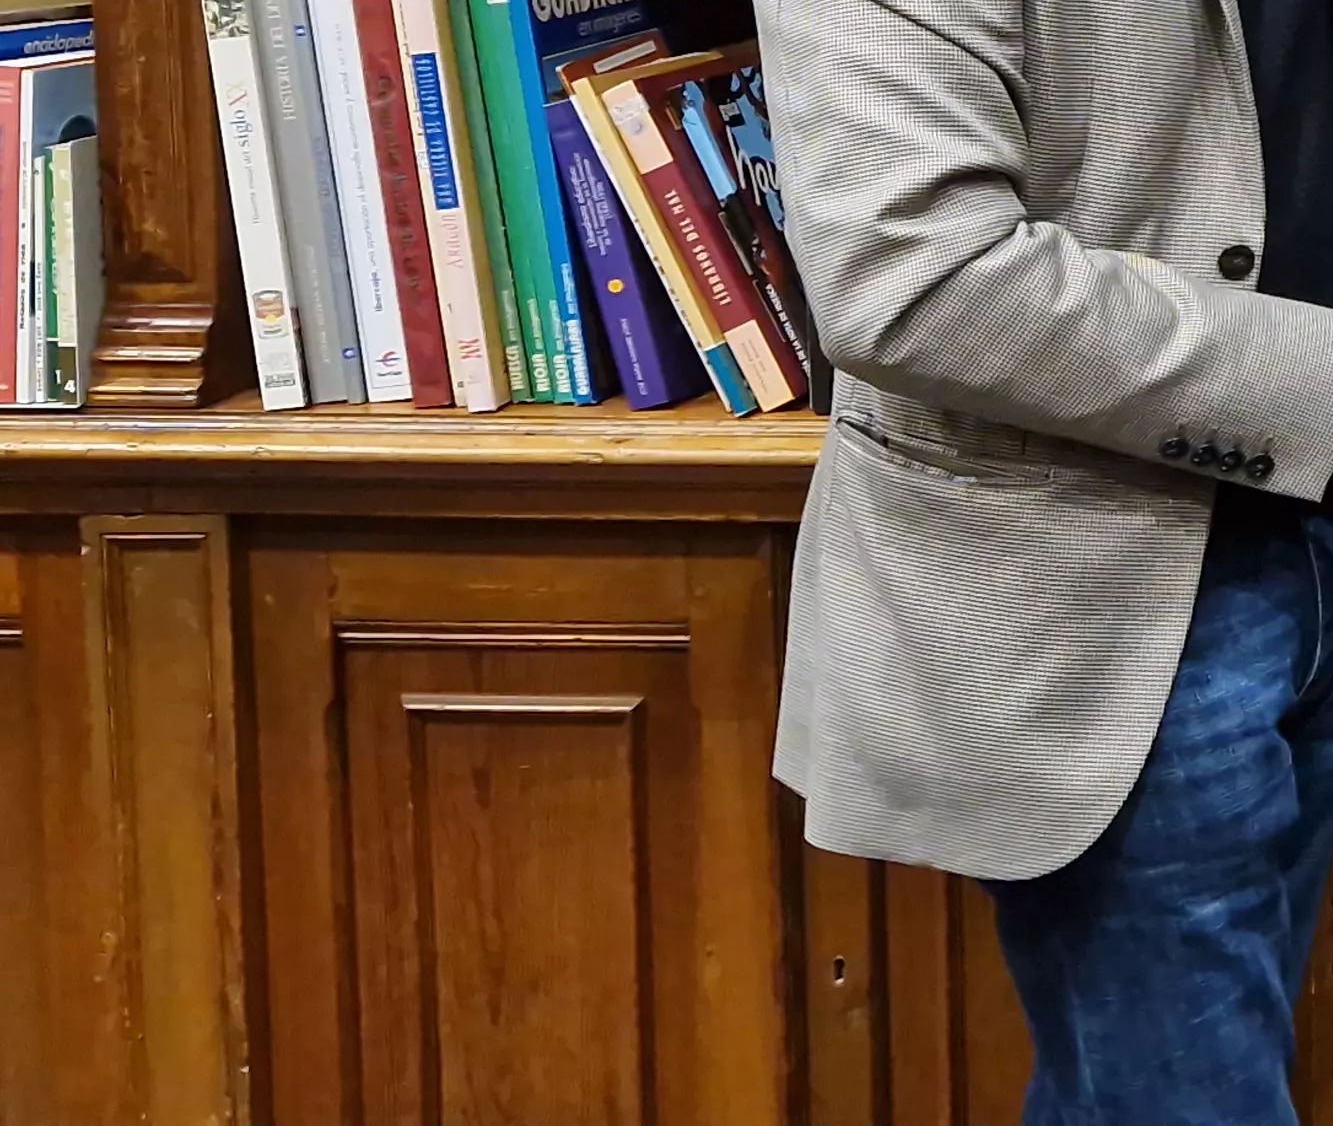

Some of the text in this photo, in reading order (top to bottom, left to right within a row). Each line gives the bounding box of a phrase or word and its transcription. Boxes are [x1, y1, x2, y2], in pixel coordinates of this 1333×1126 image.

[269, 23, 285, 49] DEL
[225, 79, 253, 148] siglo XX
[273, 54, 296, 121] HISTORIA
[662, 188, 733, 307] LÍBRANOS DEL MAL
